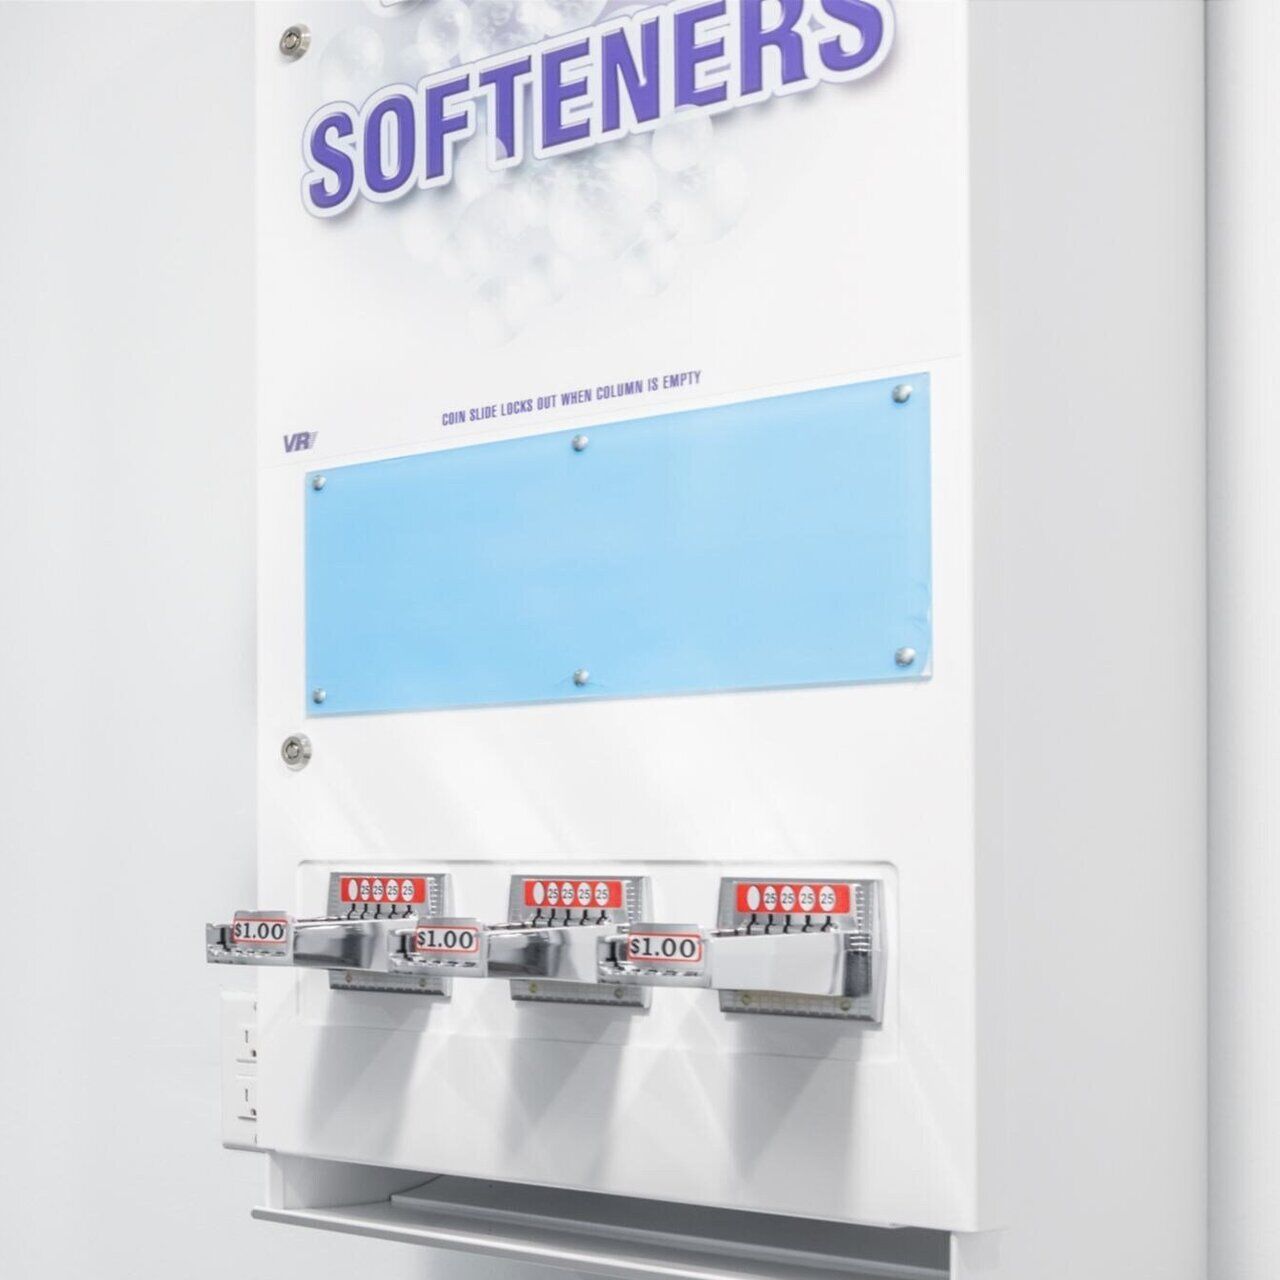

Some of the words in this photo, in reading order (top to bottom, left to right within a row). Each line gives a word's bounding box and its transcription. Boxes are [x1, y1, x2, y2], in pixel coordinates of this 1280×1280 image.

[305, 0, 886, 212] SOFTENERS
[442, 409, 466, 426] COIN
[469, 404, 497, 422] SLIDE
[501, 398, 533, 417] LOCKS
[537, 394, 557, 411] OUT
[561, 389, 592, 406] WHEN
[596, 380, 643, 401] COLUMN
[647, 377, 658, 391] IS
[663, 370, 701, 389] EMPTY
[361, 886, 370, 895] 25
[373, 886, 383, 895] 25
[387, 886, 397, 895] 25
[403, 886, 413, 895] 25
[548, 889, 558, 899] 25
[562, 889, 574, 899] 25
[579, 889, 591, 899] 25
[596, 889, 608, 899] 25
[764, 893, 776, 904] 25
[781, 893, 793, 904] 25
[800, 893, 813, 904] 25
[821, 893, 833, 904] 25
[234, 922, 284, 940] $1.00
[417, 930, 473, 949] $1.00
[630, 938, 696, 958] $1.00
